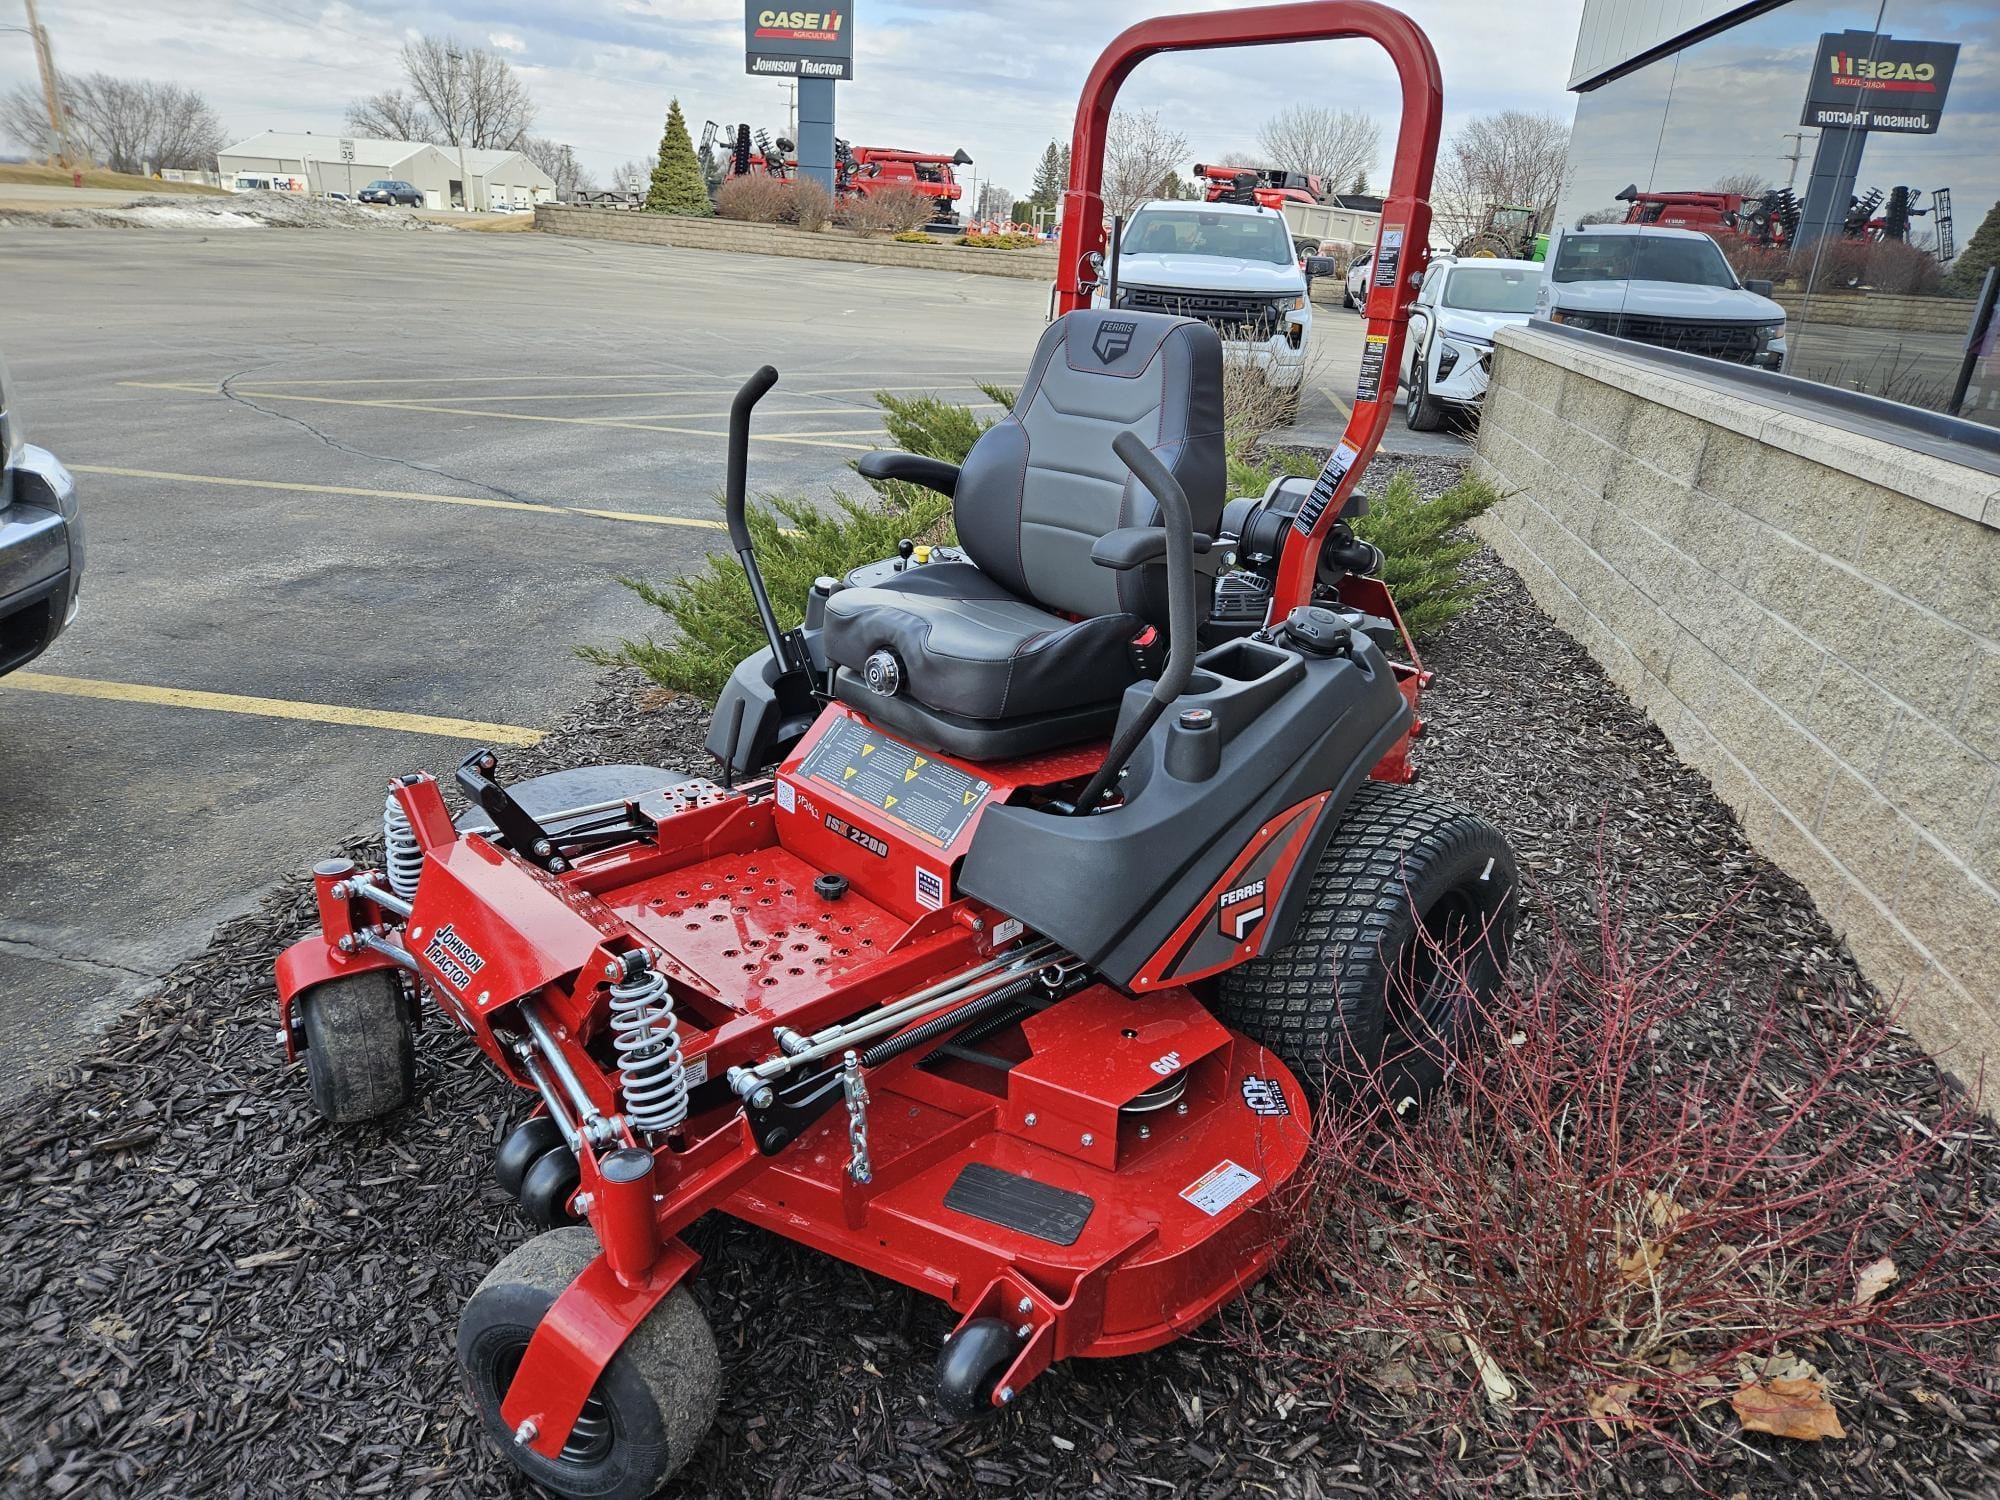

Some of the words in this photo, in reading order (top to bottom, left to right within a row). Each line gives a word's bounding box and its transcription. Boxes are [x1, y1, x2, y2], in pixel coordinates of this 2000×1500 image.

[758, 10, 820, 30] CASE
[793, 31, 835, 40] AGRICULTURE
[752, 57, 797, 73] JOHNSON
[800, 60, 843, 76] TRACTOR
[342, 150, 354, 159] 35
[273, 177, 304, 191] FedEx
[1132, 292, 1267, 310] CHEVROLET
[1101, 321, 1134, 333] FERRIS
[826, 814, 849, 836] ISX
[851, 828, 888, 857] 2200
[1221, 880, 1264, 906] FERRIS
[436, 924, 485, 973] JOHNSON
[424, 939, 470, 989] TRACTOR
[1150, 1051, 1180, 1075] 60"
